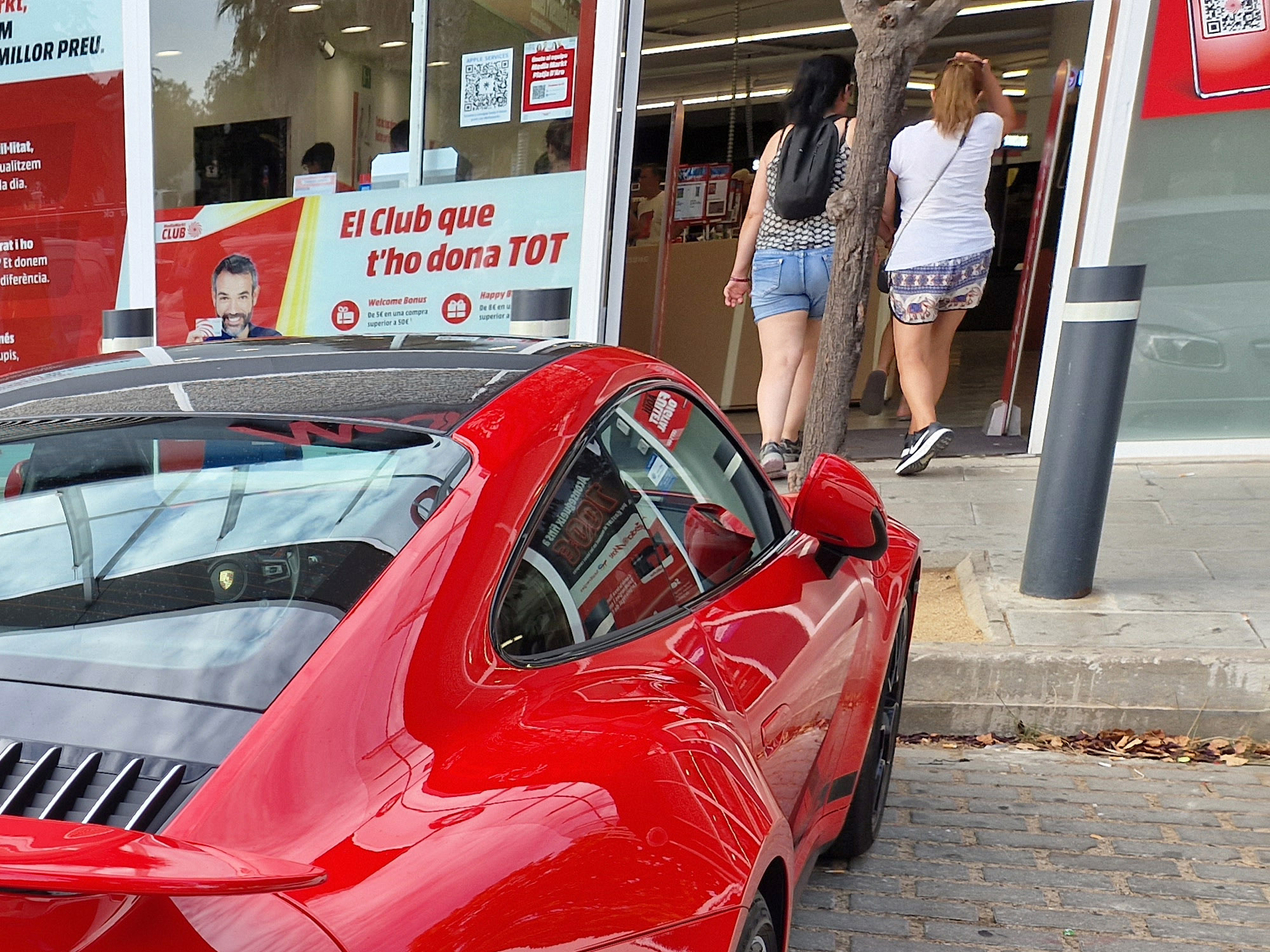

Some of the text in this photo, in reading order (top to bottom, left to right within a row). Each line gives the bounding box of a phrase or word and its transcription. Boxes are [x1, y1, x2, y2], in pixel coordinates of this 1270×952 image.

[57, 35, 105, 60] PREU.
[9, 178, 28, 190] dia.
[340, 203, 495, 239] El Club que
[162, 227, 187, 240] CLUB
[20, 238, 34, 250] ho
[366, 232, 569, 278] t'ho dona TOT
[3, 258, 12, 269] Et
[14, 256, 48, 268] donem
[0, 272, 50, 286] diferència.
[368, 296, 427, 306] Welcome Bonus
[480, 291, 505, 300] Happy
[367, 320, 392, 328] superior
[398, 318, 409, 326] 50€
